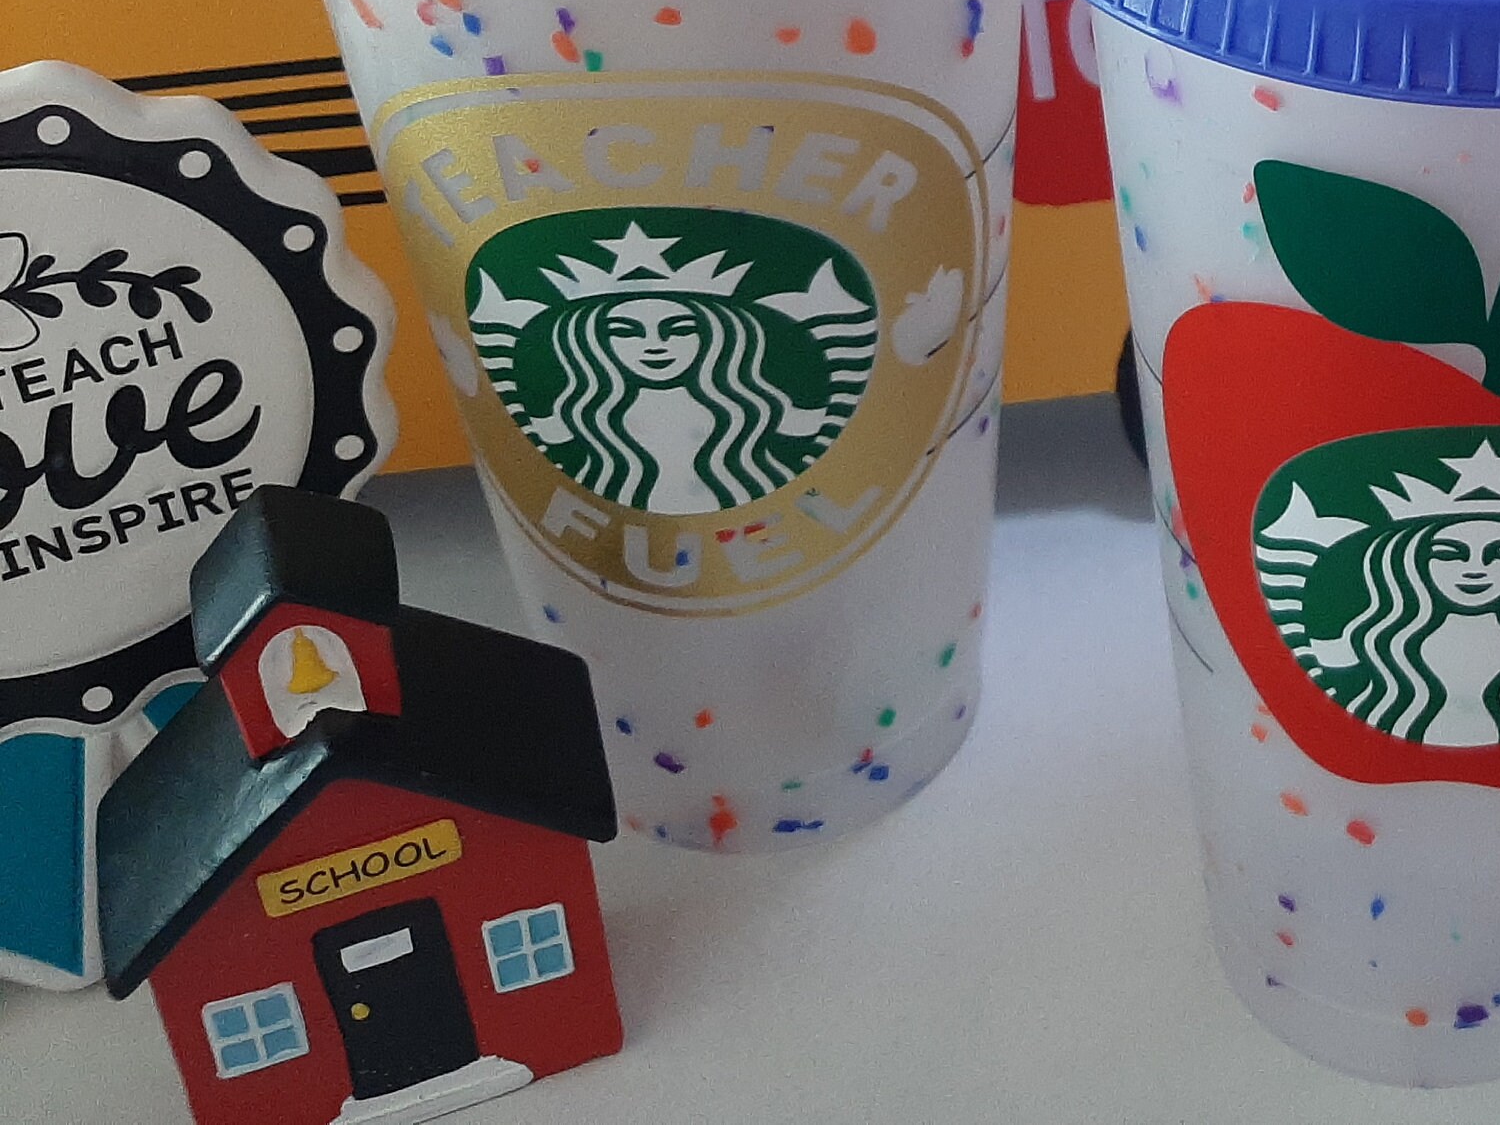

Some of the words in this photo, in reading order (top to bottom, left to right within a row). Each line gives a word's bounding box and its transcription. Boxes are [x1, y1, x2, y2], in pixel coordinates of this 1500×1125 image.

[403, 123, 918, 248] TEACHER
[536, 485, 884, 589] FUEL
[279, 837, 447, 904] SCHOOL
